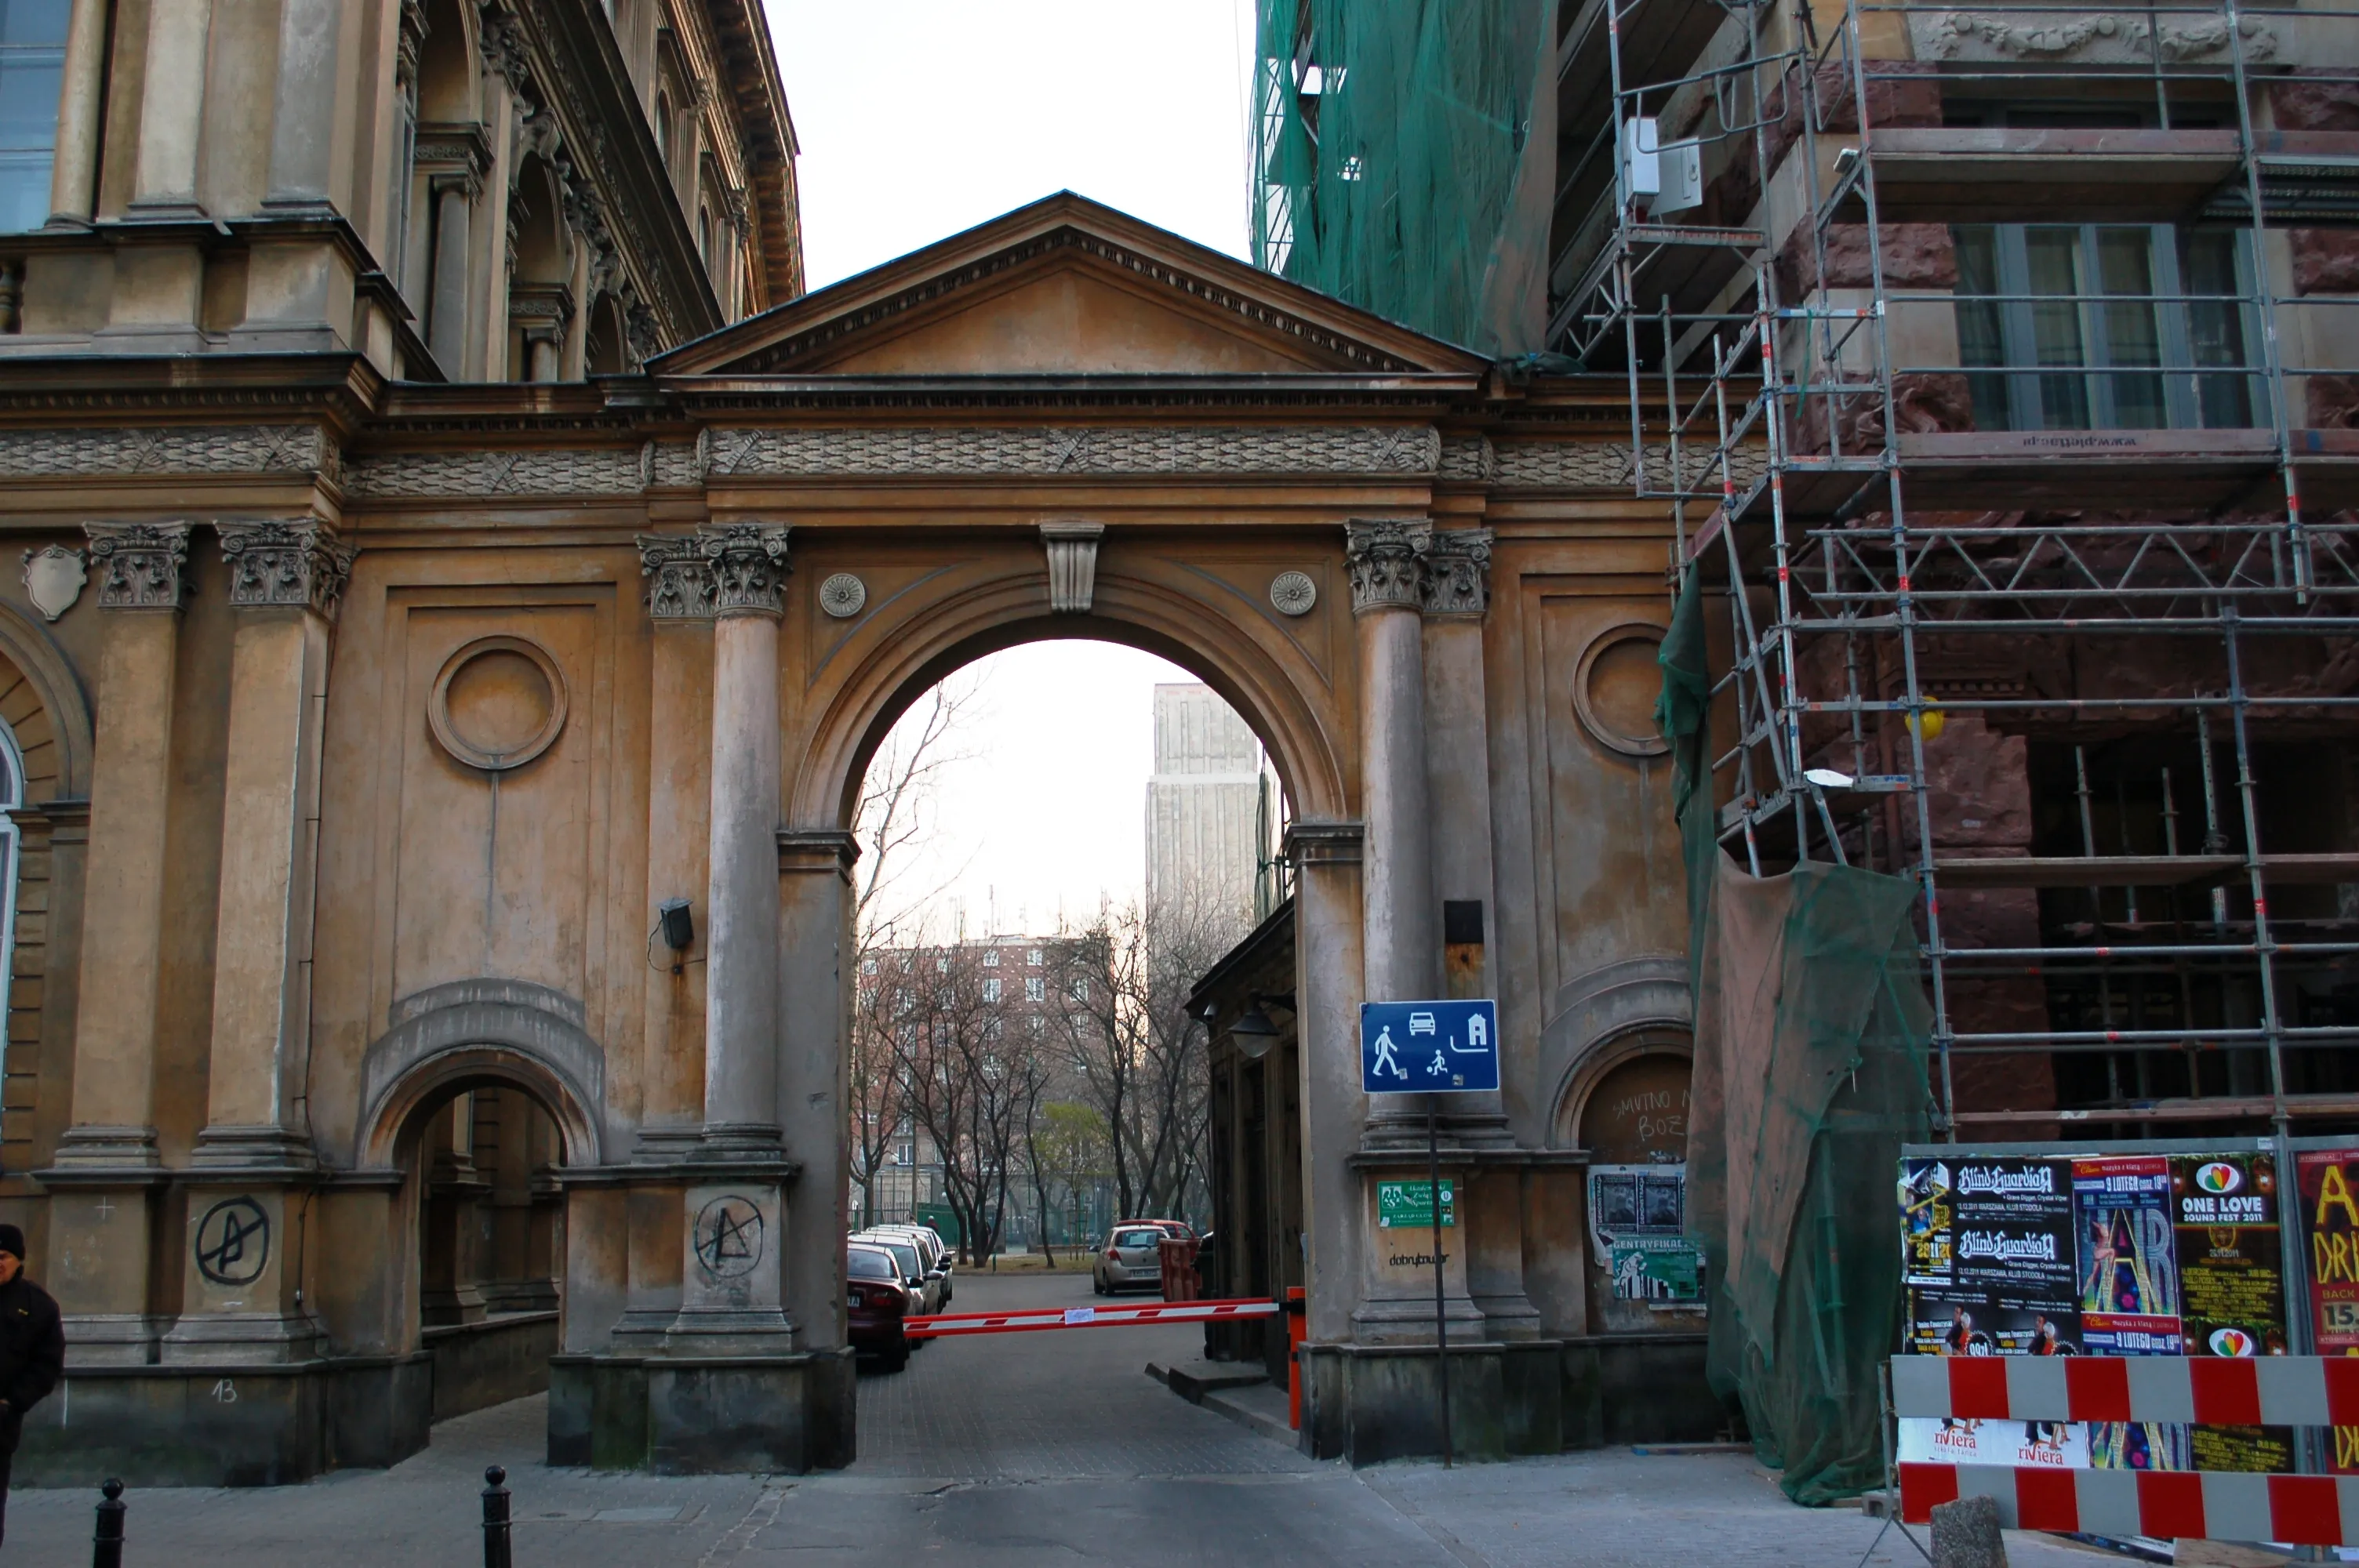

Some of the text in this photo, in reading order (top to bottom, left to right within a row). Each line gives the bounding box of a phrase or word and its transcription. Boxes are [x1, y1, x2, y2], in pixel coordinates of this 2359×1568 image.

[1613, 1091, 1670, 1120] SMUTNO
[1957, 1165, 2052, 1195] Blind Guardian
[2106, 1177, 2111, 1192] 9
[2113, 1176, 2139, 1192] LUTEGO
[2182, 1196, 2263, 1213] ONE LOVE
[2183, 1214, 2215, 1222] SOUND
[2243, 1213, 2263, 1221] 2011
[1613, 1239, 1695, 1249] GENTRYFIKAC
[1958, 1229, 2055, 1260] Blind Guardian
[2322, 1289, 2355, 1299] BACK
[2116, 1332, 2122, 1348] 9
[2124, 1332, 2150, 1348] LUTEGO
[211, 1378, 238, 1403] 13
[1934, 1426, 1976, 1449] riviera
[2018, 1440, 2063, 1465] riviera
